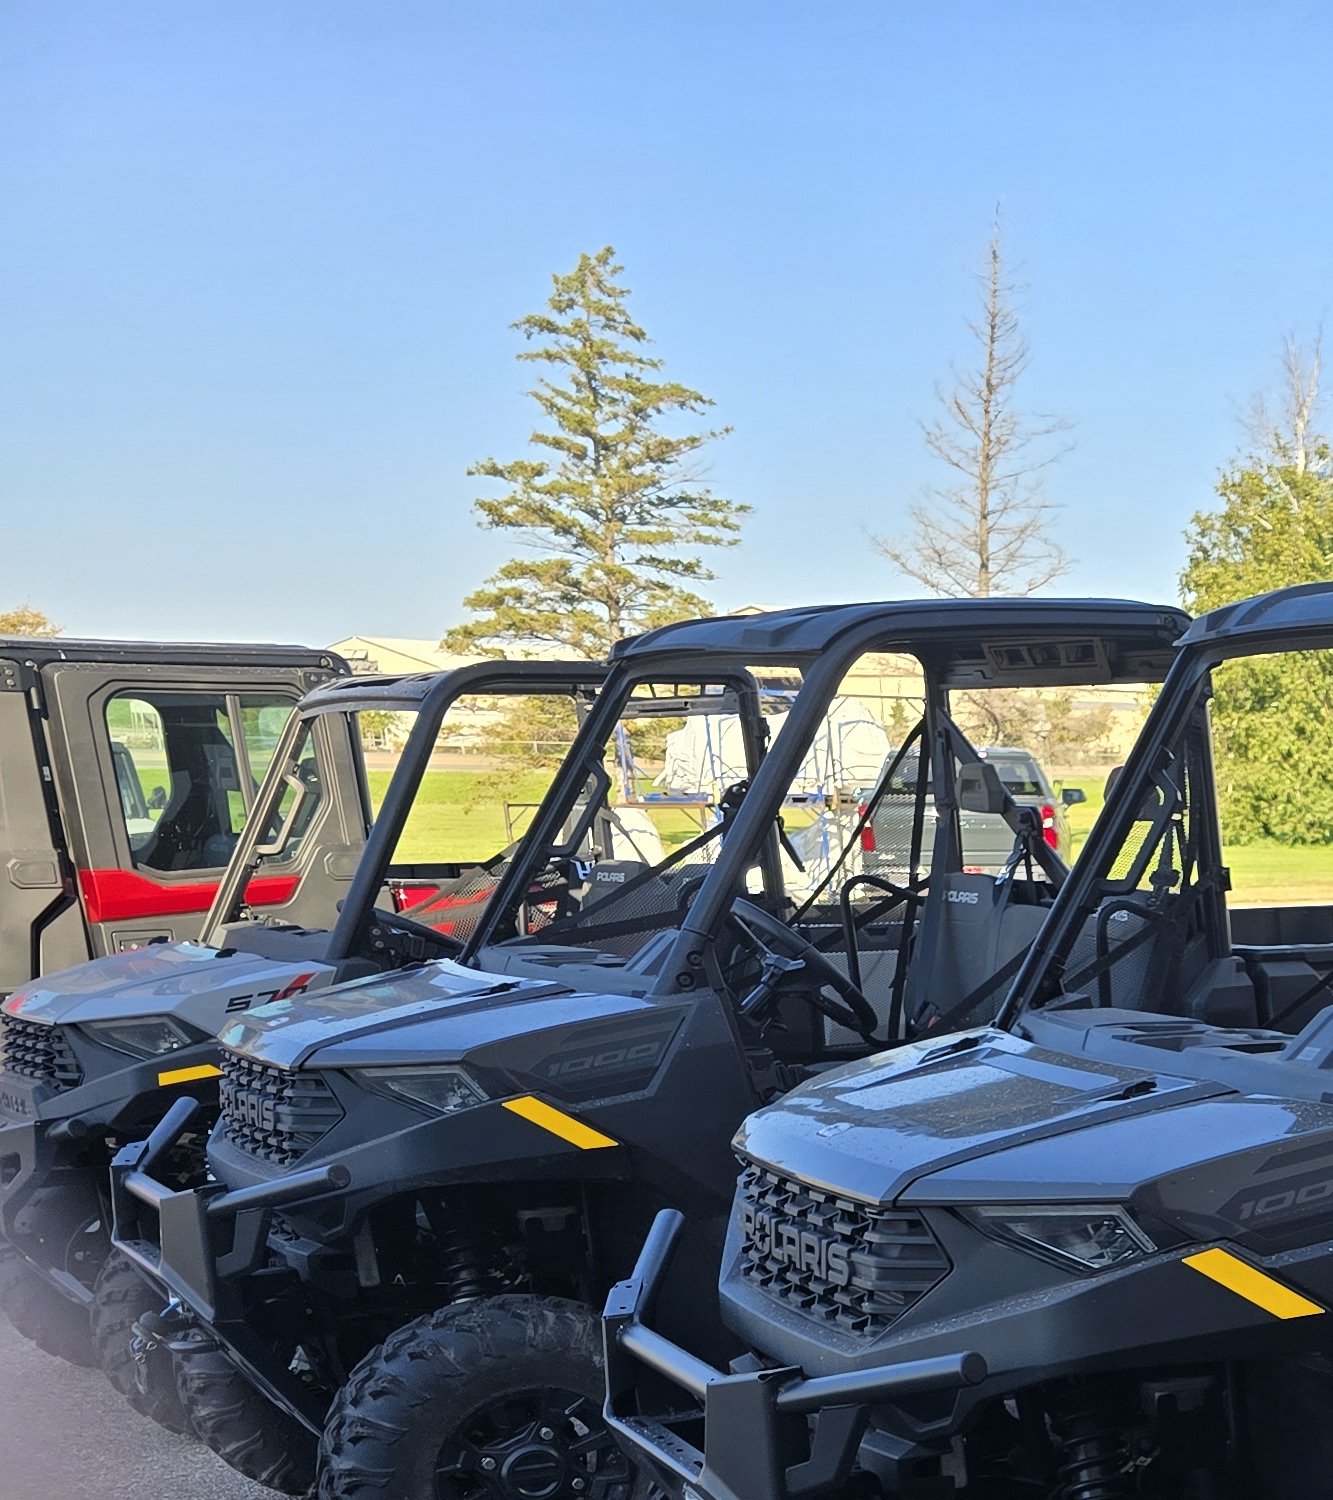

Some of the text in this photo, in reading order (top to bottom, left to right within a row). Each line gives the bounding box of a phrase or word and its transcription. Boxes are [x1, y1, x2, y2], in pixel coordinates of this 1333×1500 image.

[597, 871, 626, 884] POLARIS
[548, 1041, 661, 1077] 1000
[742, 1203, 850, 1288] POLARIS
